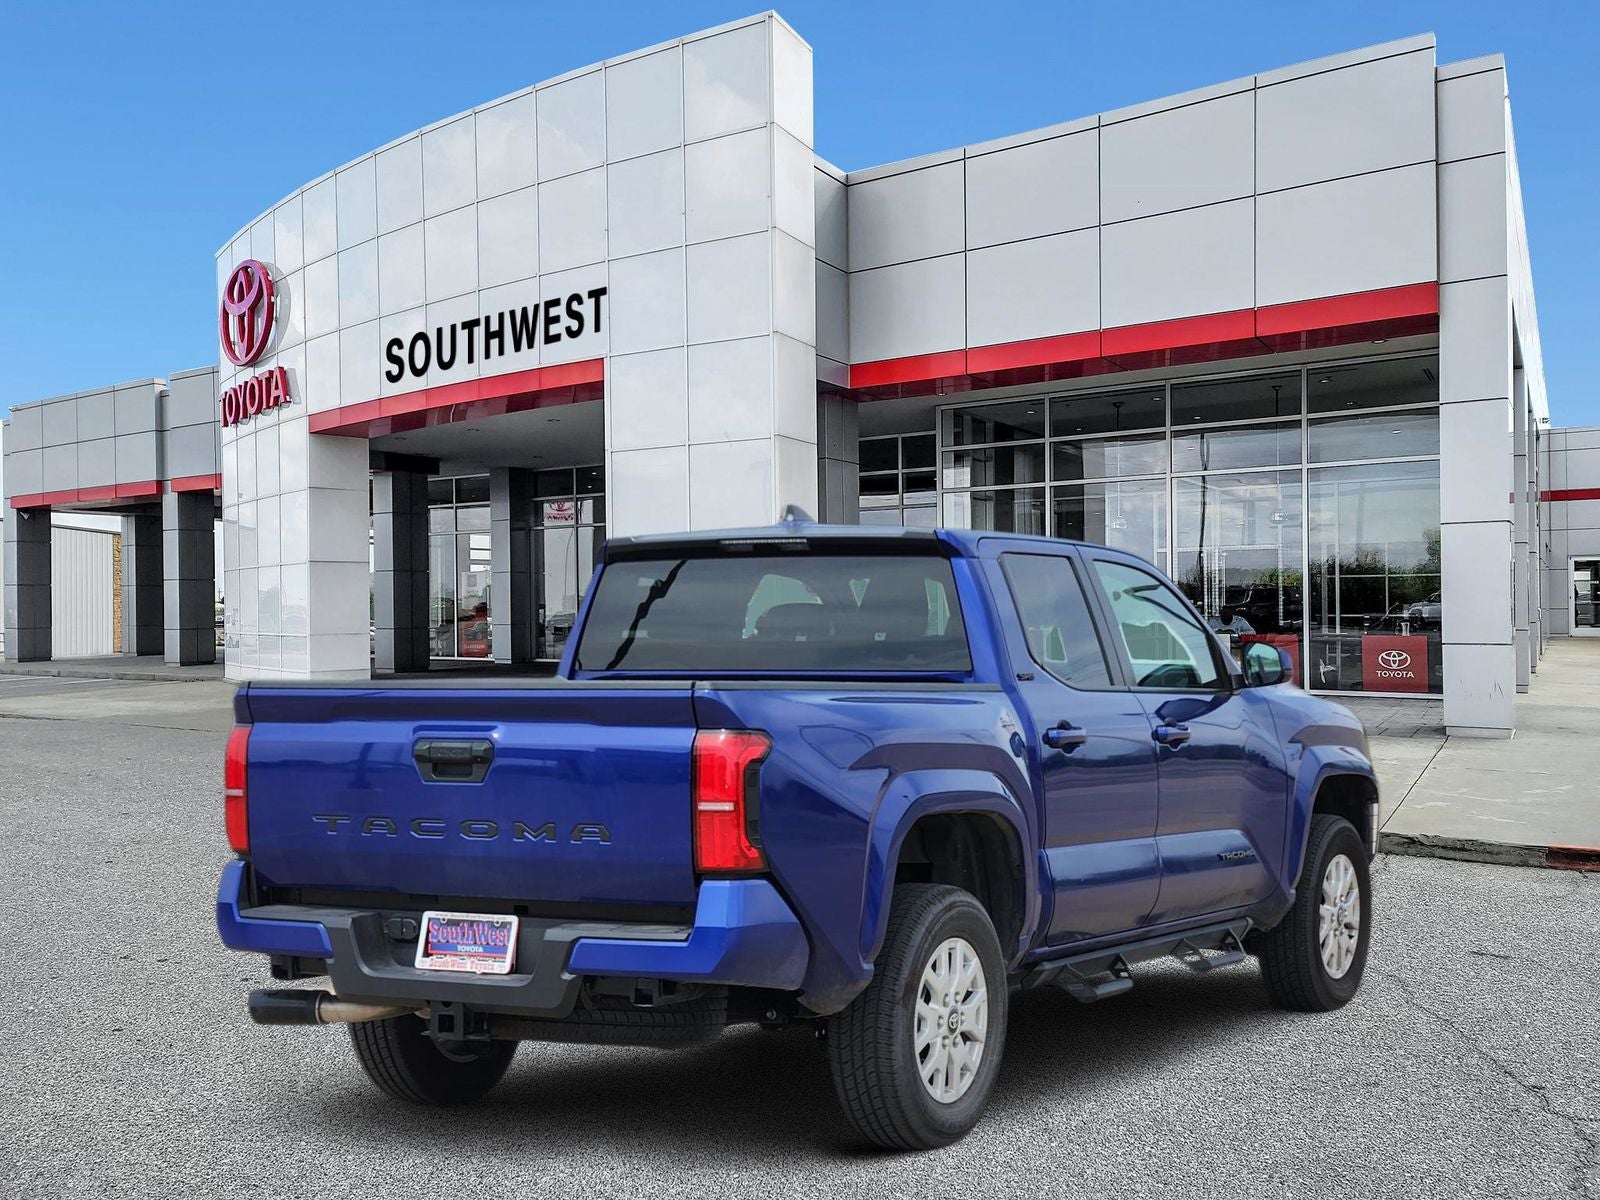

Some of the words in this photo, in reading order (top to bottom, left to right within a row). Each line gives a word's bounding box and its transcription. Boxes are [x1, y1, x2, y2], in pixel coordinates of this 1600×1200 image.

[385, 286, 608, 384] SOUTHWEST
[219, 366, 291, 428] TOYOTA
[1376, 670, 1415, 678] TOYOTA
[311, 815, 612, 845] TACOMA
[457, 945, 484, 953] TOYOTA
